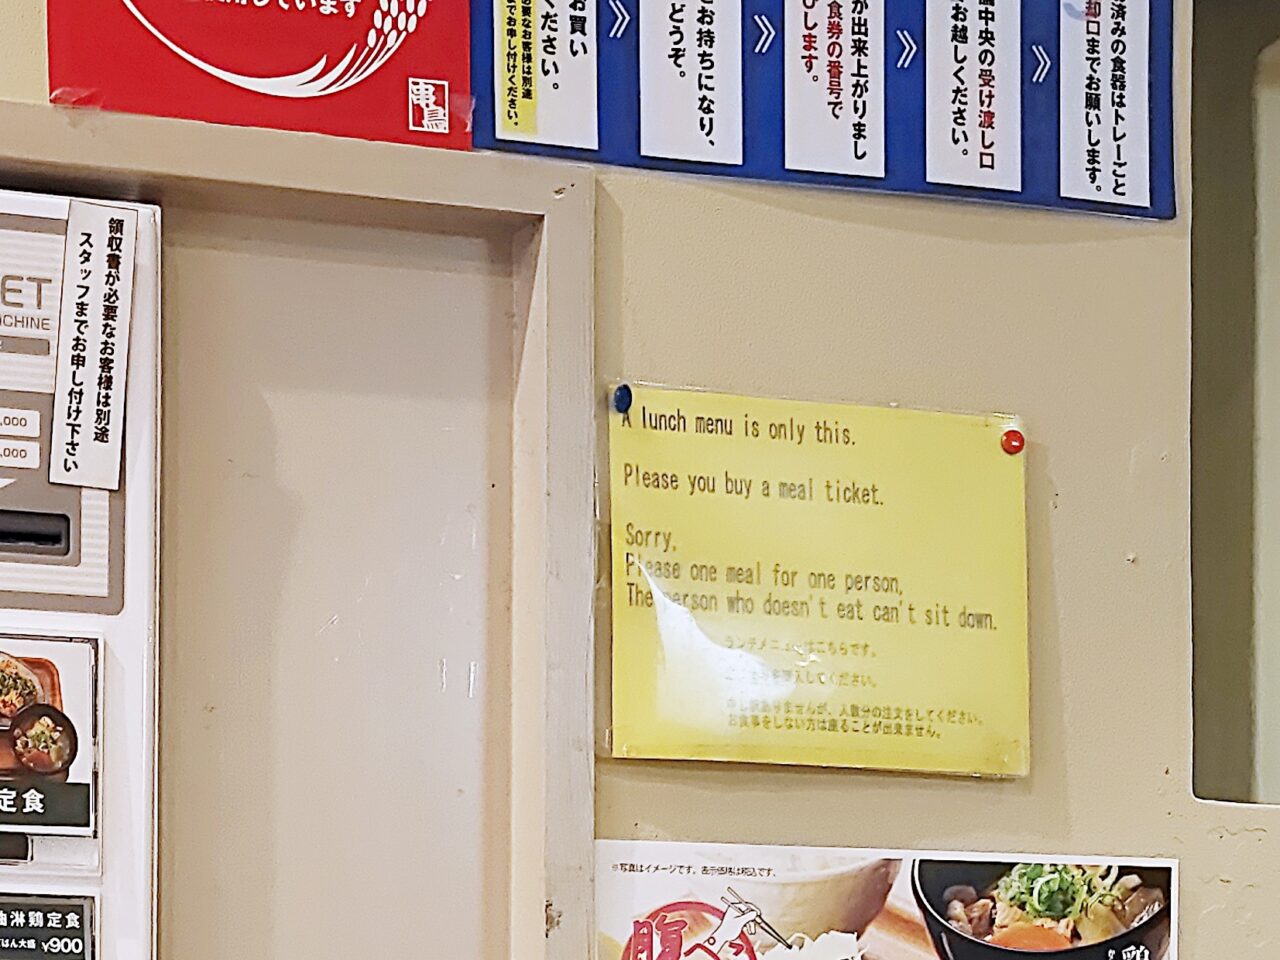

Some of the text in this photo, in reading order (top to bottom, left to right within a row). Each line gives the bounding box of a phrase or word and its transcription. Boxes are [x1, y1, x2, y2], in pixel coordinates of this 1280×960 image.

[506, 0, 518, 126] でお申し付けください。
[521, 0, 533, 99] 要なお客様は別途
[697, 0, 715, 146] お持ちになり、
[827, 0, 843, 119] 食券の番号で
[950, 0, 969, 156] お越しください。
[1110, 0, 1126, 196] 済みの食器はトレーごと
[64, 233, 93, 472] スタッフまでお申し付け下さい
[93, 218, 124, 443] 領収書が必要なお客様は別途
[642, 406, 686, 433] lunch
[695, 415, 733, 435] menu
[745, 413, 760, 439] is
[768, 418, 805, 445] only
[815, 420, 856, 446] this.
[623, 464, 884, 505] Please you buy a meal ticket.
[625, 523, 677, 553] Sorry,
[626, 582, 653, 607] The
[663, 590, 718, 611] erson
[727, 591, 754, 614] who
[836, 599, 863, 621] eat
[925, 601, 950, 627] sit
[958, 607, 997, 632] down.
[690, 563, 718, 581] one
[726, 562, 761, 586] meal
[773, 565, 798, 588] for
[808, 573, 835, 590] one
[845, 573, 904, 597] person,
[41, 938, 83, 954] ¥900
